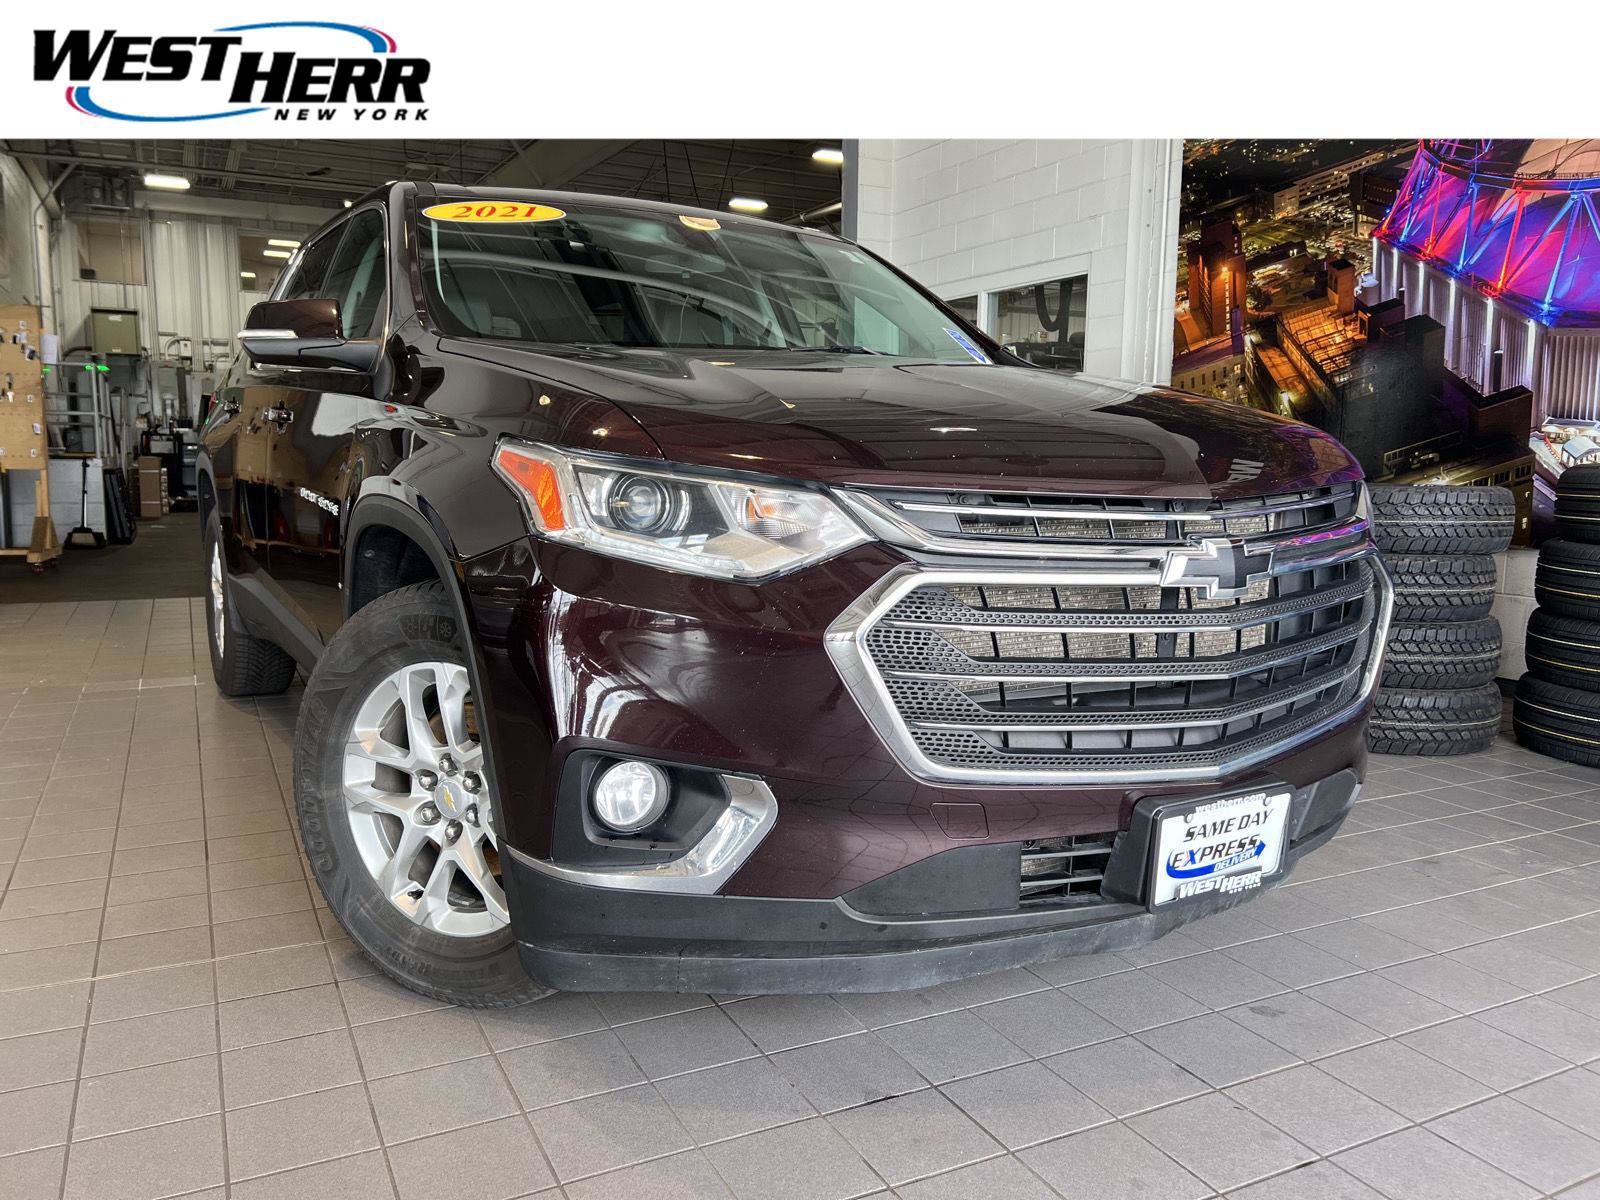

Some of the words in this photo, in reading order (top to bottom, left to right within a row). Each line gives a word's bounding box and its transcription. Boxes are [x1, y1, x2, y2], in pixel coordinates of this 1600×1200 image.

[452, 205, 537, 218] 2021
[1183, 818, 1236, 842] SAME
[1237, 809, 1274, 830] DAY
[1171, 834, 1260, 869] EXPRESS
[1179, 875, 1225, 899] WEST
[1219, 871, 1262, 893] HERR
